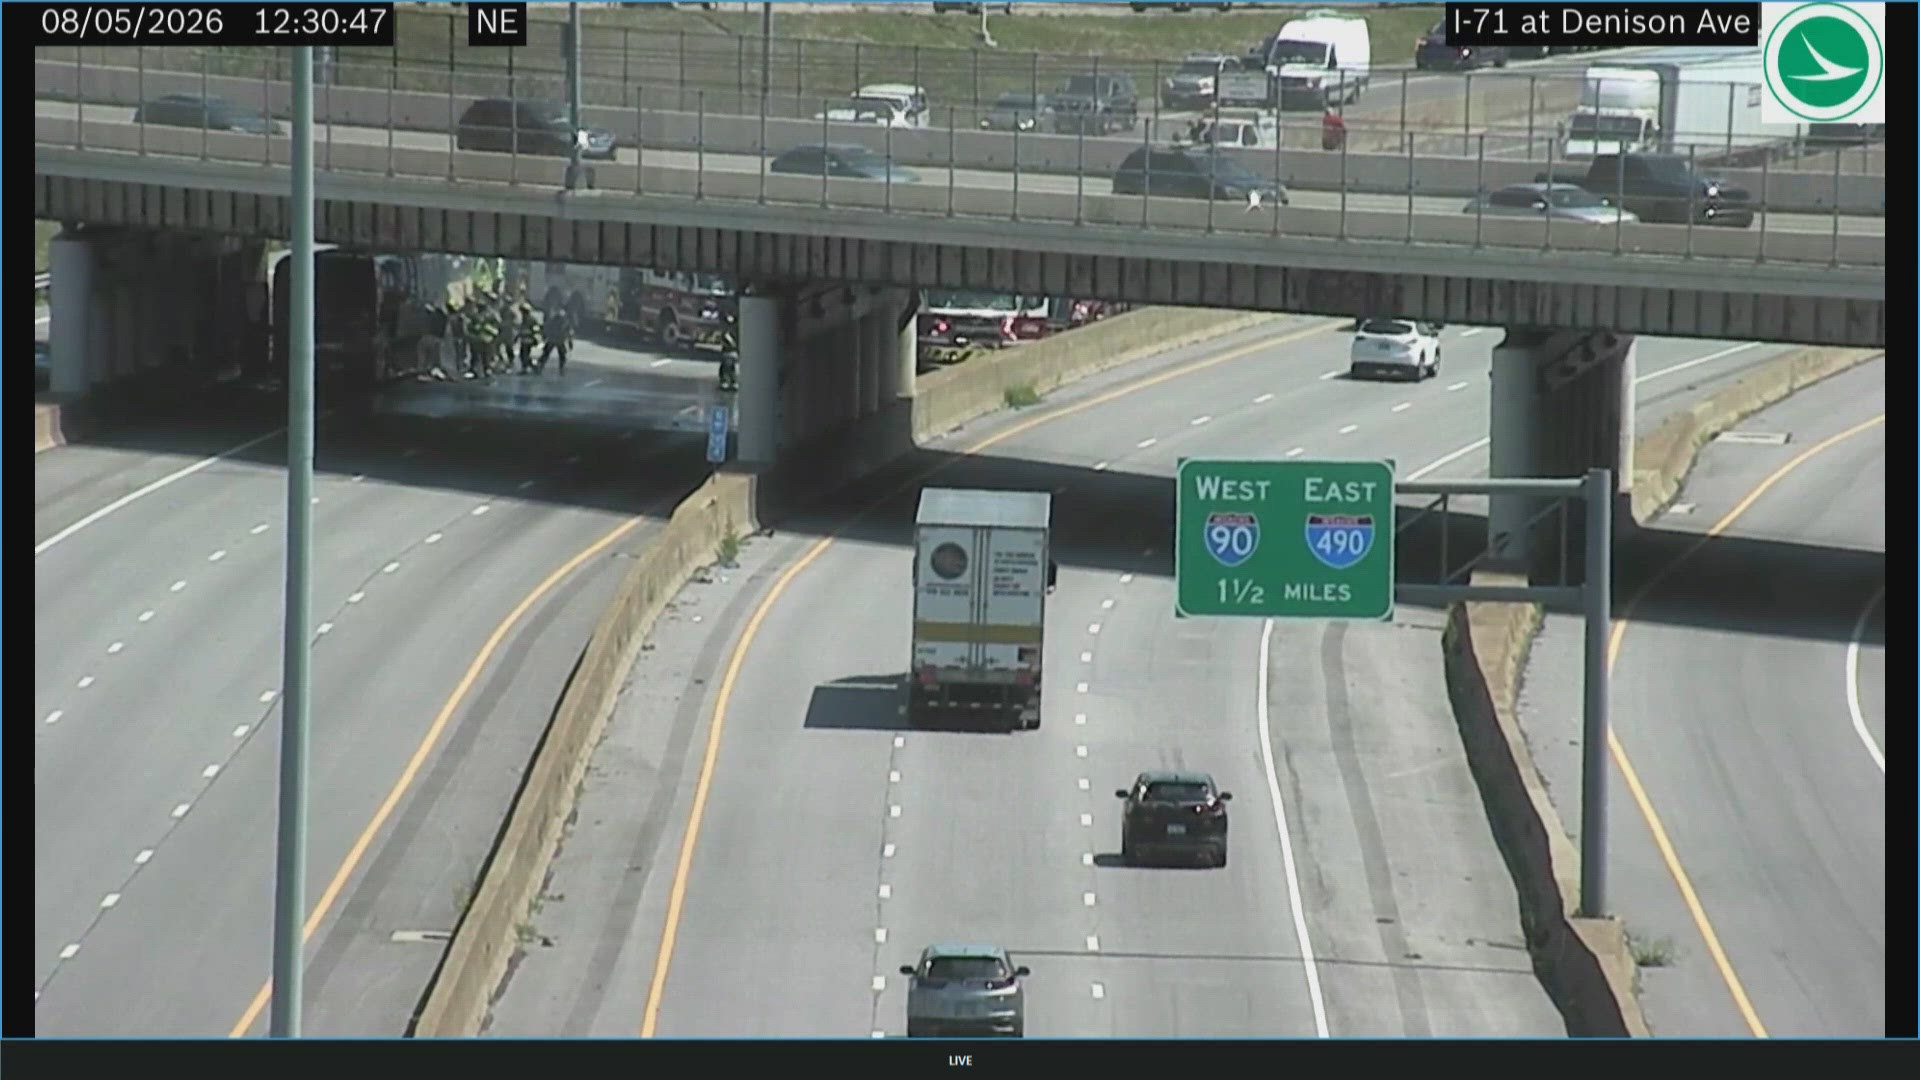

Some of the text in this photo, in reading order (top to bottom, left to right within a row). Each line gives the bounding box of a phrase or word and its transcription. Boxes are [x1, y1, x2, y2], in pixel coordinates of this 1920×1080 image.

[1195, 475, 1271, 501] WEST
[1304, 477, 1377, 503] EAST
[1211, 526, 1253, 556] 90
[1316, 530, 1365, 555] 490
[1284, 583, 1352, 602] MILES
